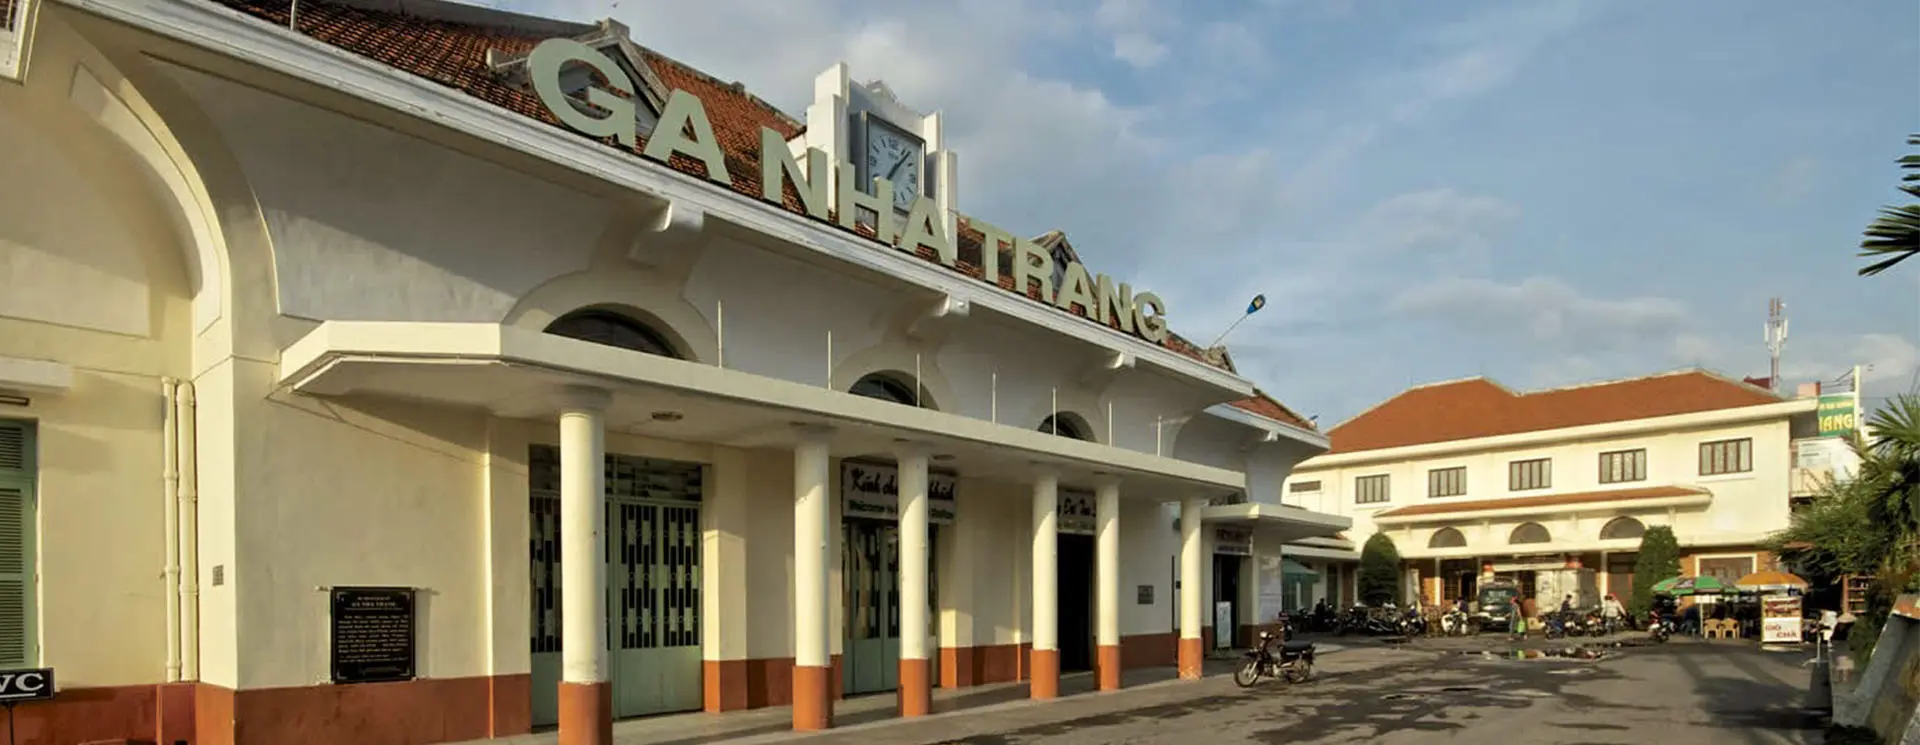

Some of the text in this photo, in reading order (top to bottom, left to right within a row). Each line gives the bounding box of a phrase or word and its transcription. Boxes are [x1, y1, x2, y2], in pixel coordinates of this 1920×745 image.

[526, 37, 1168, 344] GA NHA TRANG
